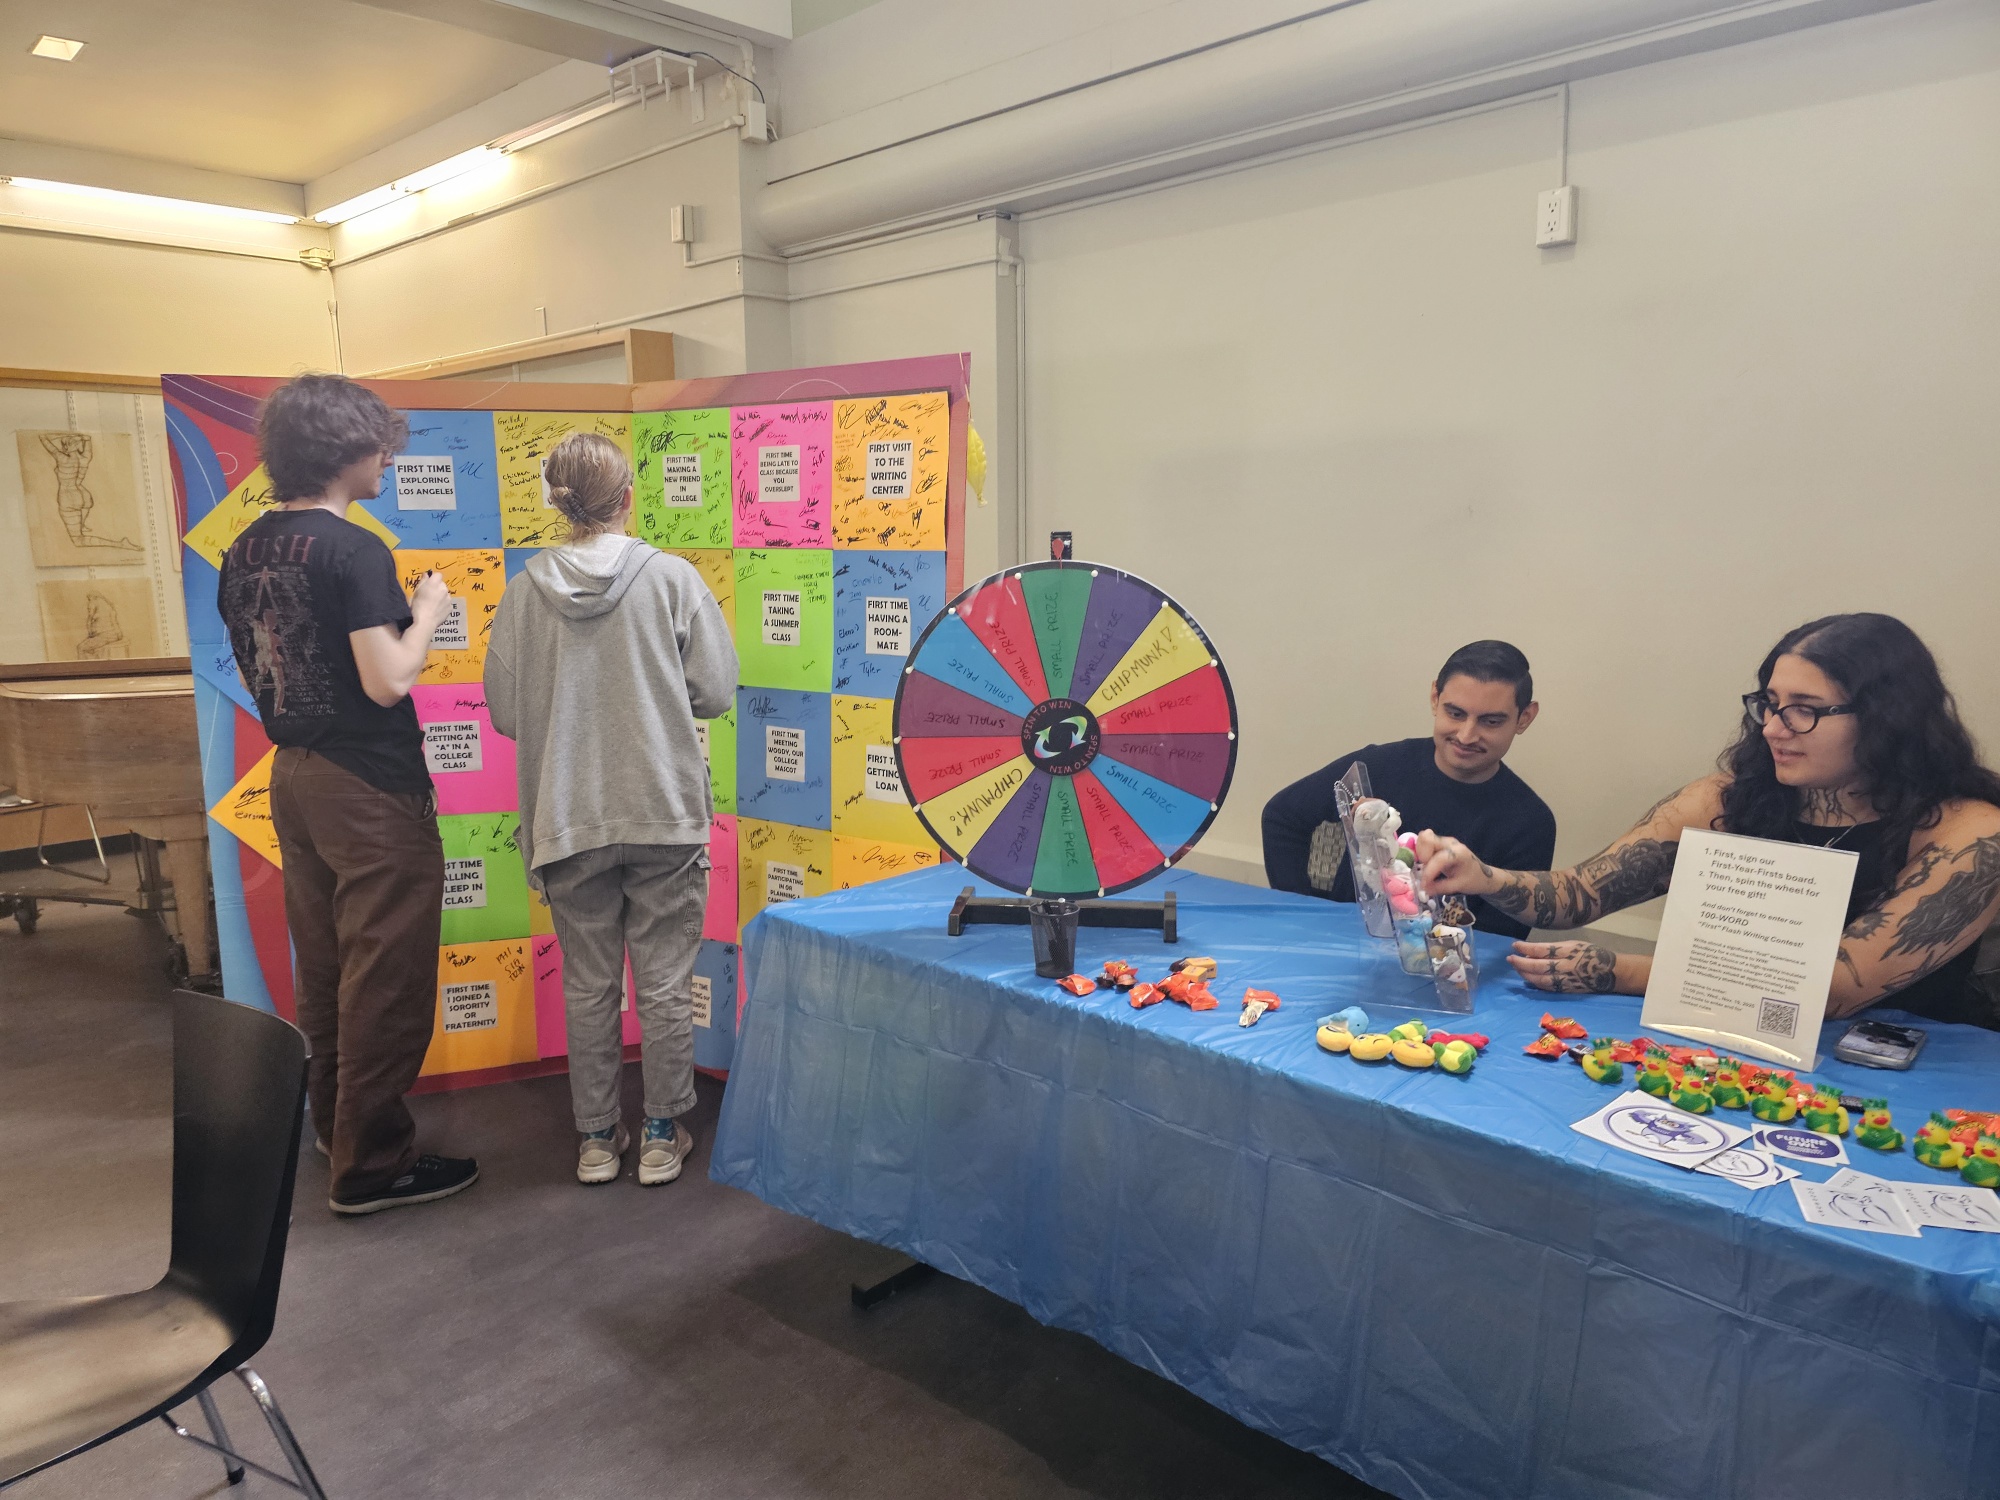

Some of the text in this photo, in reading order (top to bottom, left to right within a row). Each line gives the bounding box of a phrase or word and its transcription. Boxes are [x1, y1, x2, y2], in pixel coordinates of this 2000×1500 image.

[869, 443, 911, 453] FIRST VISIT
[875, 458, 904, 467] TO THE
[397, 464, 451, 473] FIRST TIME
[401, 476, 450, 484] EXPLORING
[679, 475, 700, 483] FRIEND
[871, 471, 907, 481] WRITING
[872, 486, 903, 495] CENTER
[228, 535, 317, 570] RUSH
[764, 594, 799, 602] FIRST TIME
[868, 600, 908, 610] FIRST TIME
[769, 607, 794, 615] TAKING
[868, 614, 900, 623] HAVING
[771, 620, 799, 628] SUMMER
[772, 633, 791, 641] CLASS
[874, 628, 902, 636] ROOM-
[1045, 592, 1062, 678] SMALL PRIZE
[877, 641, 899, 650] MATE
[1080, 609, 1123, 685] SMALL PRIZE
[989, 621, 1035, 687] SMALL PRIZE
[1101, 626, 1178, 701] CHIPMUNK!
[948, 658, 1014, 703] SMALL PRIZE
[1120, 695, 1194, 725] SMALL PRIZE
[923, 712, 1005, 728] SMALL PRIZE
[1024, 701, 1071, 739] SPIN TO WIN
[429, 725, 451, 733] FIRST
[426, 734, 463, 742] GETTING
[772, 730, 799, 739] FIRST TIME
[773, 739, 798, 748] MEETING
[1085, 735, 1097, 759] SPIN
[434, 752, 473, 760] COLLEGE
[768, 747, 804, 758] WOODY, OUR
[1120, 744, 1205, 762] SMALL PRIZE
[774, 756, 798, 766] COLLEGE
[867, 754, 887, 764] FIRST
[1075, 759, 1087, 769] TO
[775, 765, 797, 774] MASCOT
[928, 749, 1001, 780] SMALL PRIZE
[876, 781, 898, 791] LOAN
[1106, 765, 1177, 814] SMALL PRIZE
[950, 768, 1022, 836] CHIPMUNK!
[1008, 783, 1041, 862] SMALL PRIZE
[1087, 787, 1135, 855] SMALL PRIZE
[1058, 791, 1079, 866] SMALL PRIZE
[1714, 849, 1736, 860] First,
[1739, 854, 1757, 863] sign
[459, 860, 482, 868] TIME
[774, 867, 786, 875] FIRST
[1711, 860, 1816, 885] First-Year-Firsts board.
[444, 872, 479, 881] ALLING
[768, 874, 803, 885] PARTICIPATING
[472, 883, 482, 891] IN
[1709, 871, 1733, 883] Then,
[1736, 877, 1755, 886] spin
[1757, 880, 1772, 889] the
[1775, 884, 1804, 894] wheel
[1806, 889, 1820, 897] for
[771, 890, 796, 899] PLANNING
[1706, 884, 1766, 899] your free gift!
[445, 896, 473, 905] CLASS
[1701, 911, 1749, 926] 100-WORD
[1737, 909, 1758, 917] forget
[1768, 915, 1788, 923] enter
[1722, 926, 1741, 935] Flash
[1743, 931, 1769, 942] Writing
[1771, 936, 1804, 948] Contest!
[447, 986, 468, 994] FIRST
[452, 994, 482, 1003] JOINED
[449, 1001, 490, 1012] SORORITY
[445, 1018, 496, 1030] FRATERNITY
[1776, 1134, 1828, 1146] FUTURE
[1788, 1140, 1819, 1149] OWL
